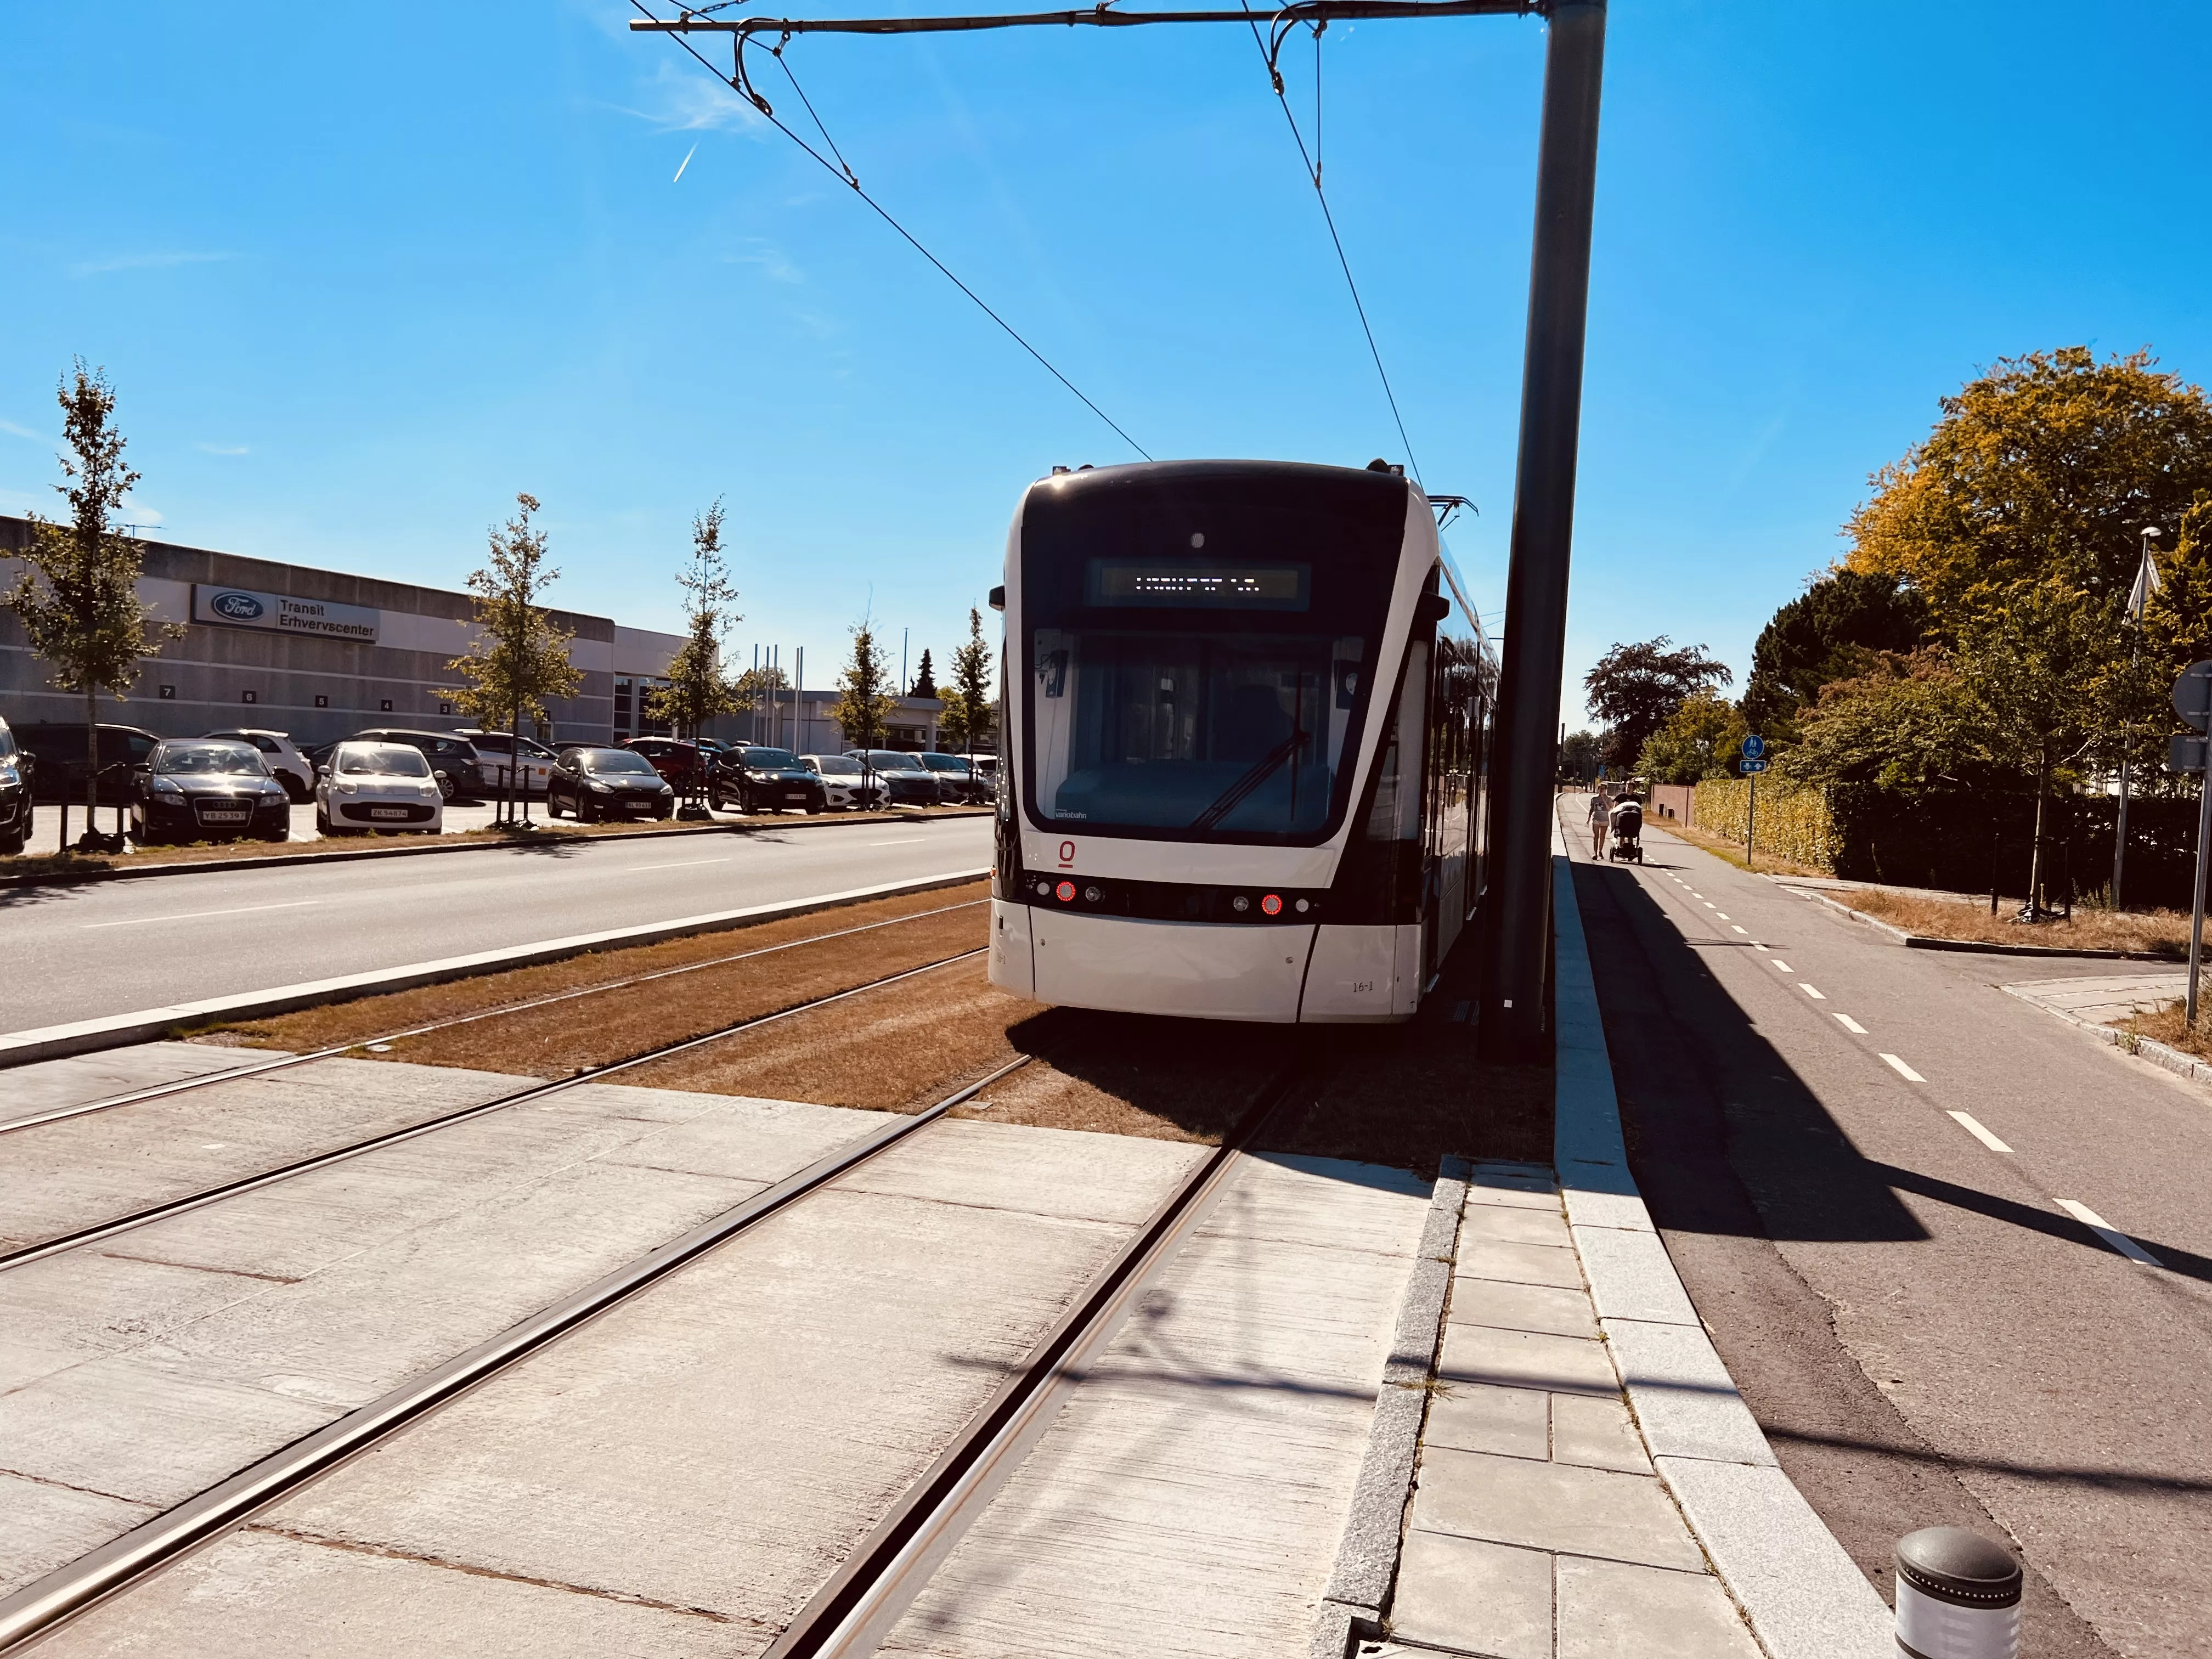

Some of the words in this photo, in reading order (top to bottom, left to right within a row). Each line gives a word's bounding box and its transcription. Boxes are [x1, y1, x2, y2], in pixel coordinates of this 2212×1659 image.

[224, 596, 256, 616] Ford
[280, 599, 325, 616] Transit
[280, 615, 374, 636] Erhvervscenter
[164, 688, 171, 696] 7
[319, 697, 325, 706] 5
[1353, 980, 1373, 992] 16-1
